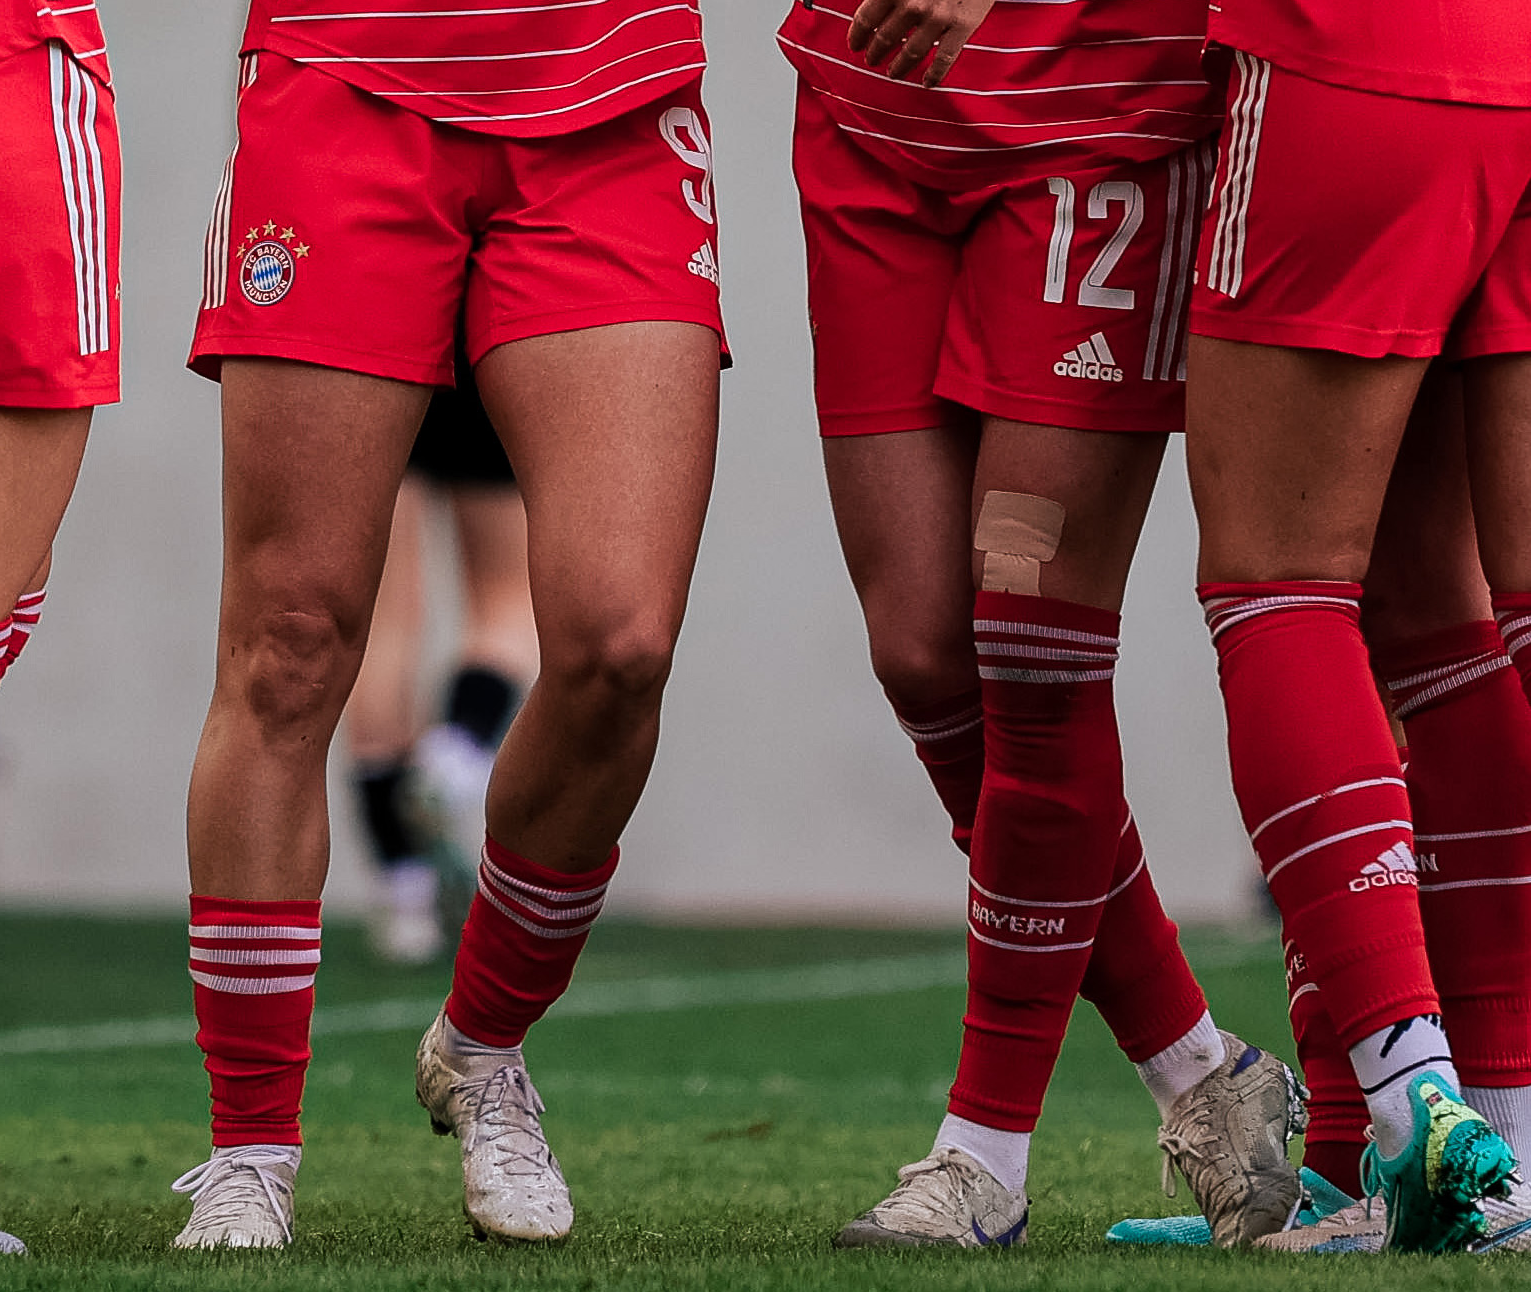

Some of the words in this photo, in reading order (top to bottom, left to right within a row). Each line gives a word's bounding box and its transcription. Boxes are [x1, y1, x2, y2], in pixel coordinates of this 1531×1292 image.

[658, 107, 714, 225] 9
[256, 246, 290, 269] BAYERN
[1043, 176, 1145, 310] 12
[1053, 360, 1124, 383] adidas
[972, 899, 1065, 936] BAYERN
